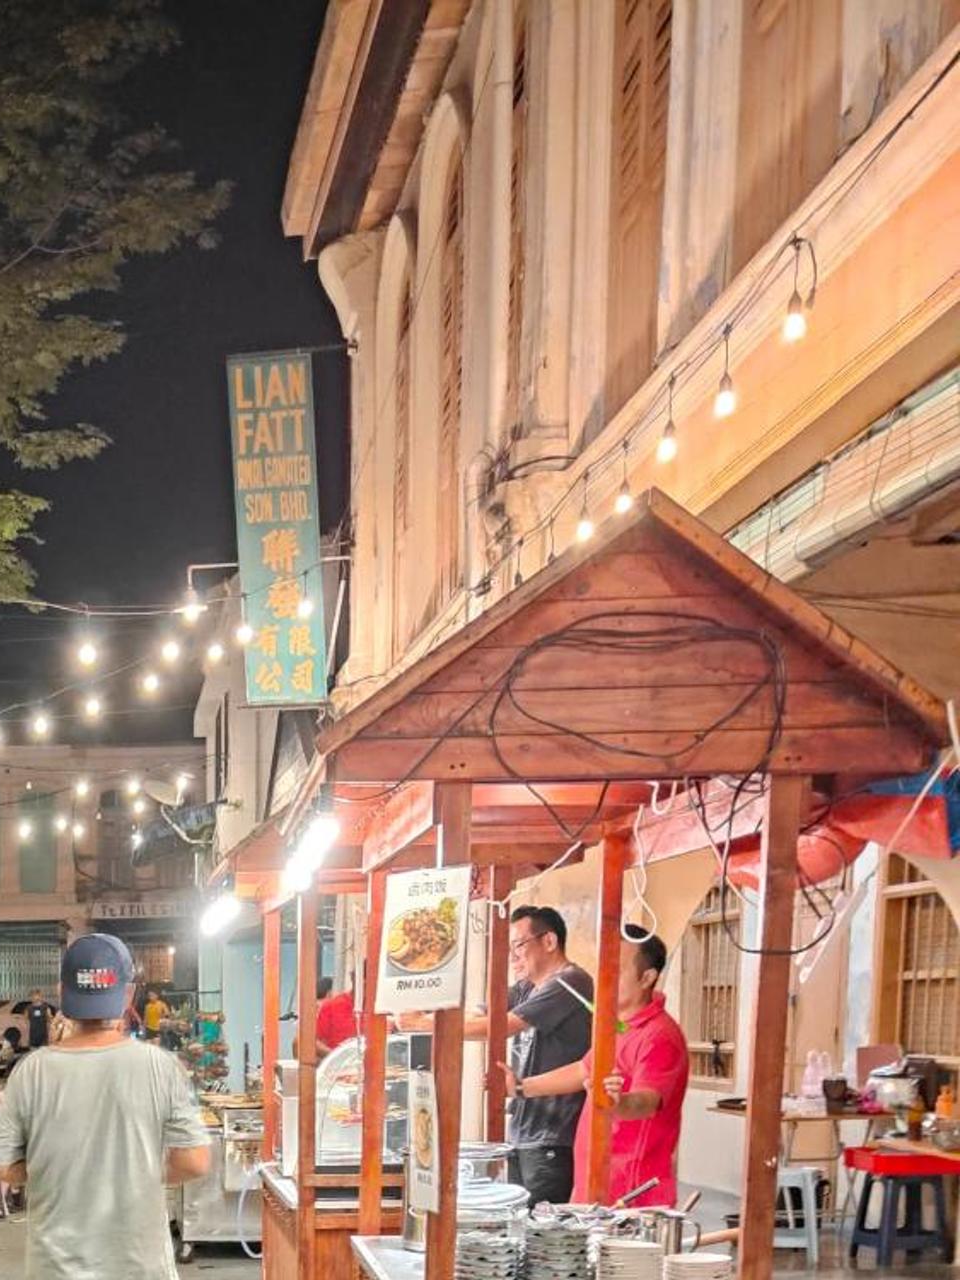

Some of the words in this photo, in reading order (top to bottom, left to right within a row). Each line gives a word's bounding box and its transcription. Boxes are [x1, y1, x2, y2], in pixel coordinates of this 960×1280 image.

[235, 363, 306, 408] LIAN
[238, 409, 305, 454] FATT
[257, 624, 317, 657] 有限
[255, 659, 315, 694] 公司
